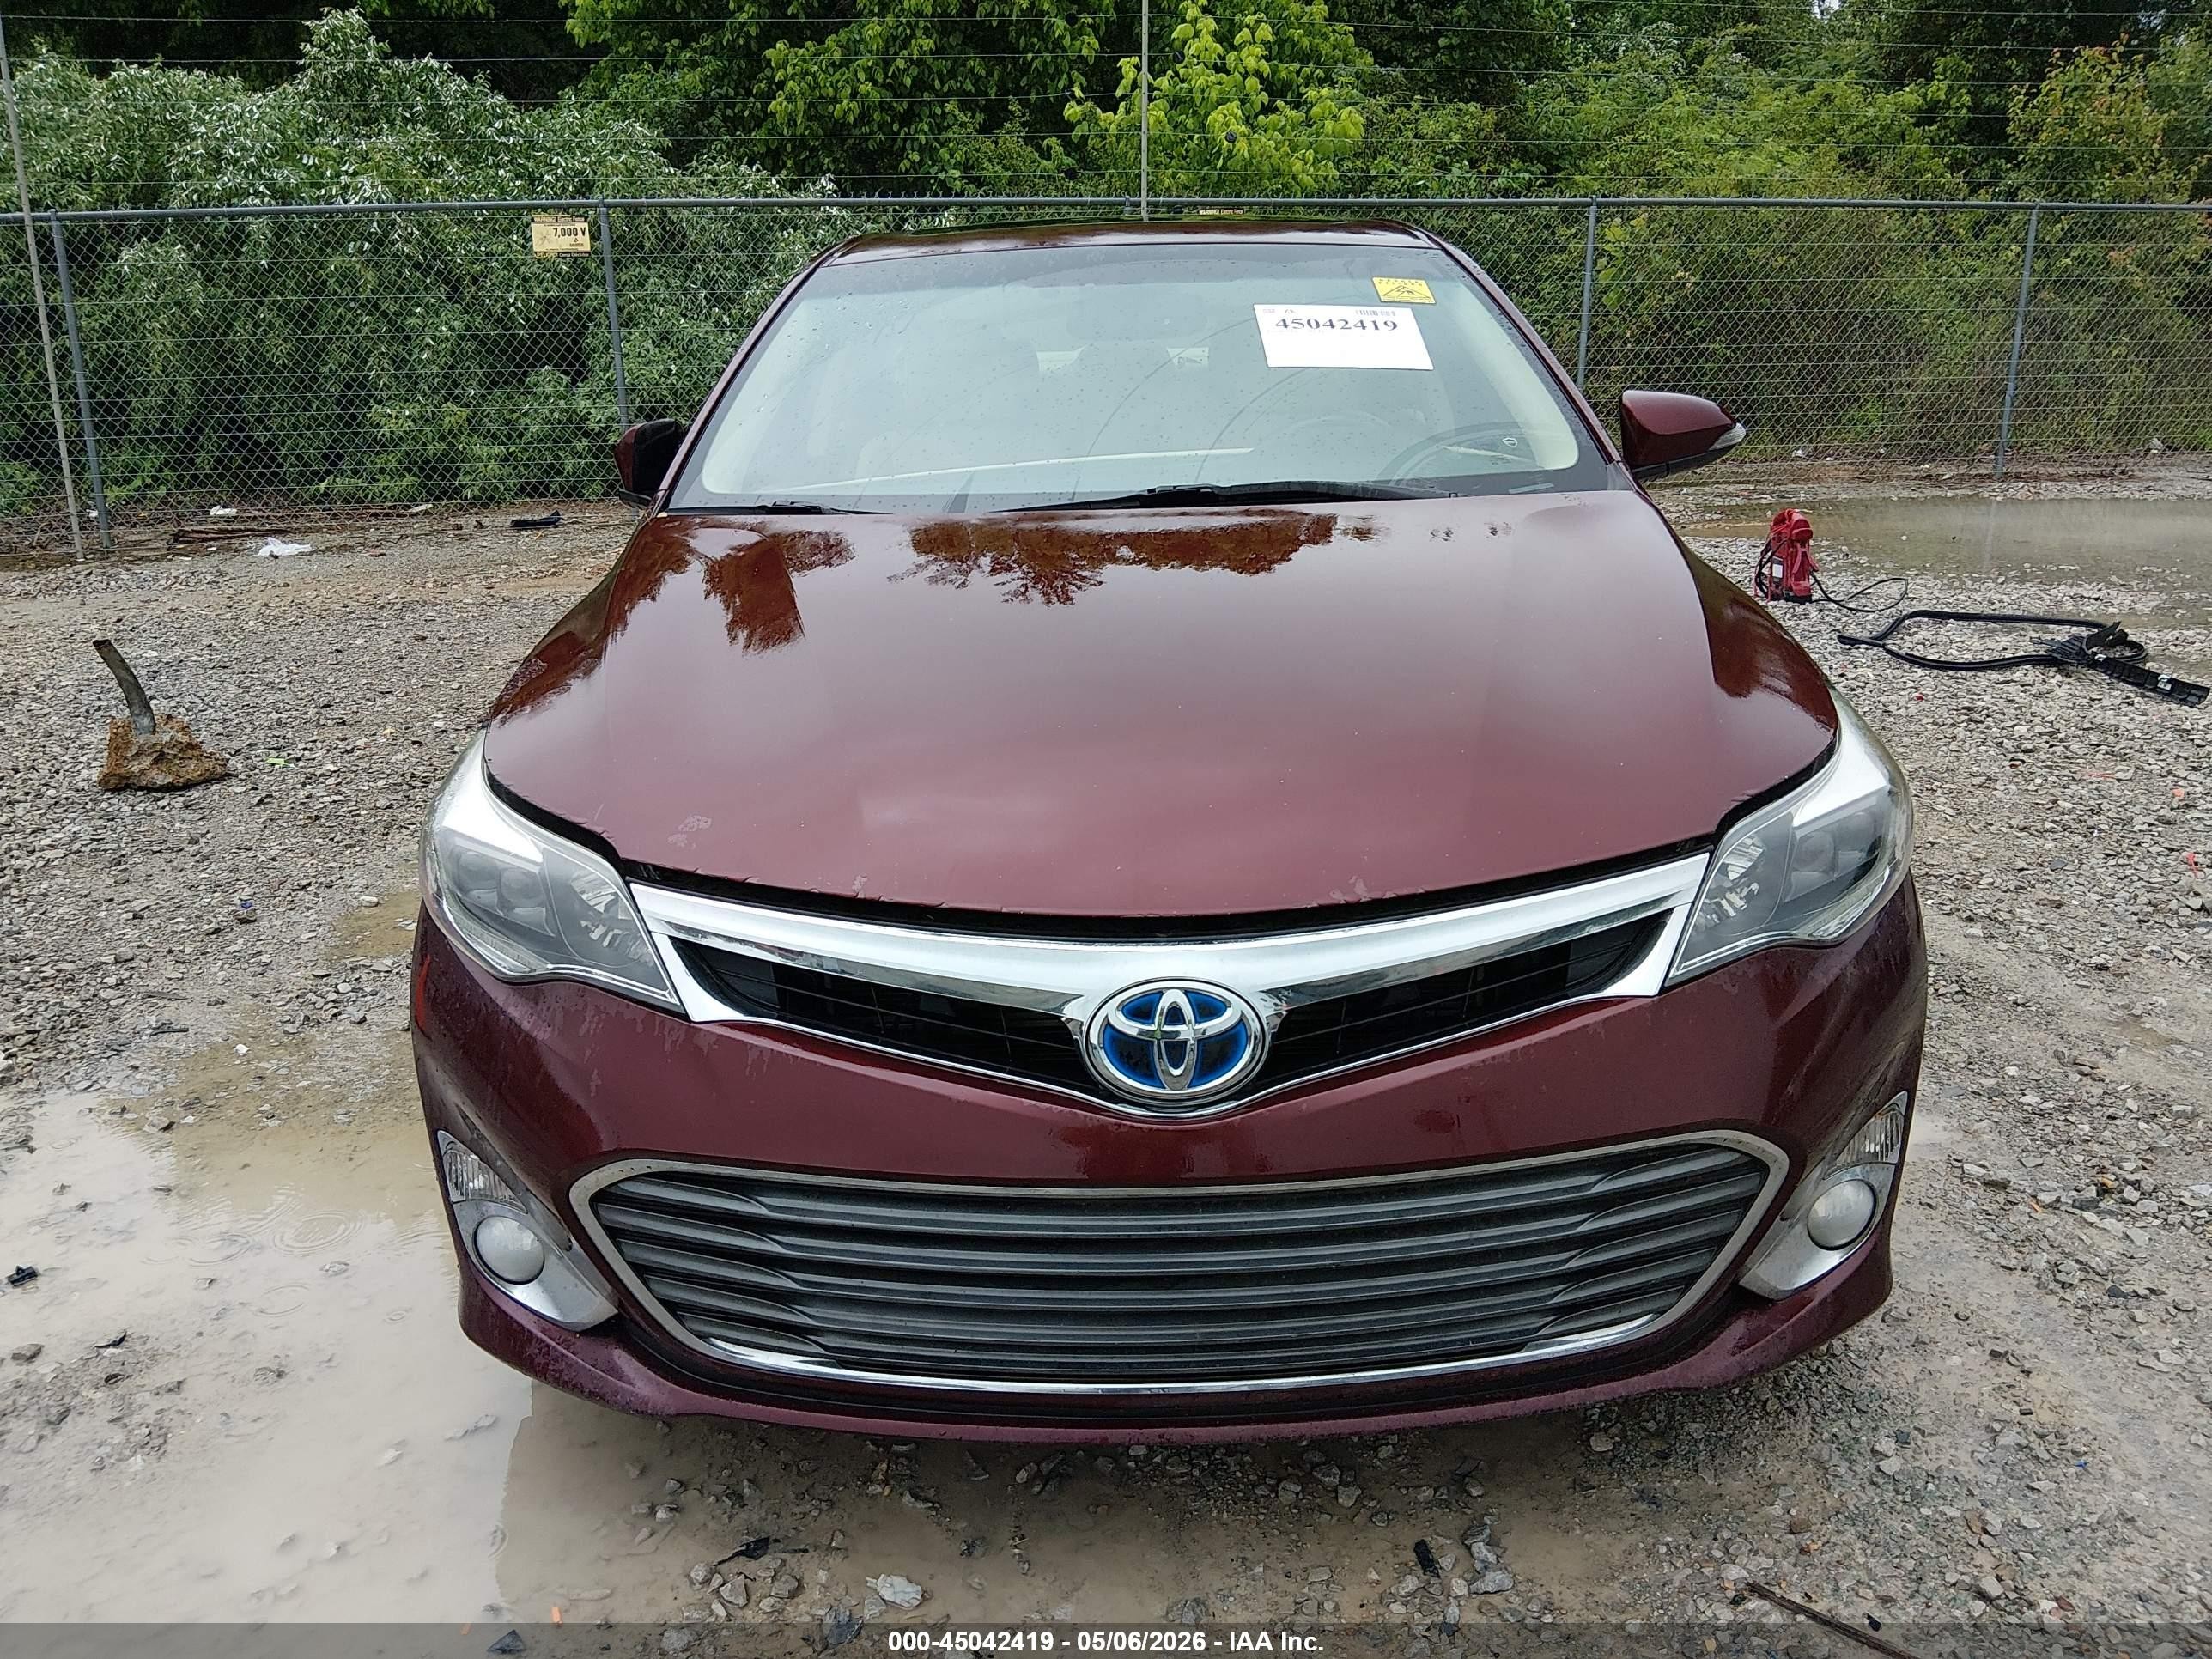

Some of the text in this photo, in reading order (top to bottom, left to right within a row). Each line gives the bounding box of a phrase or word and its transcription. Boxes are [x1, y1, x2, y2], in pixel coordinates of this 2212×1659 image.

[552, 227, 586, 238] 7,000 V
[1275, 318, 1398, 331] 45042419
